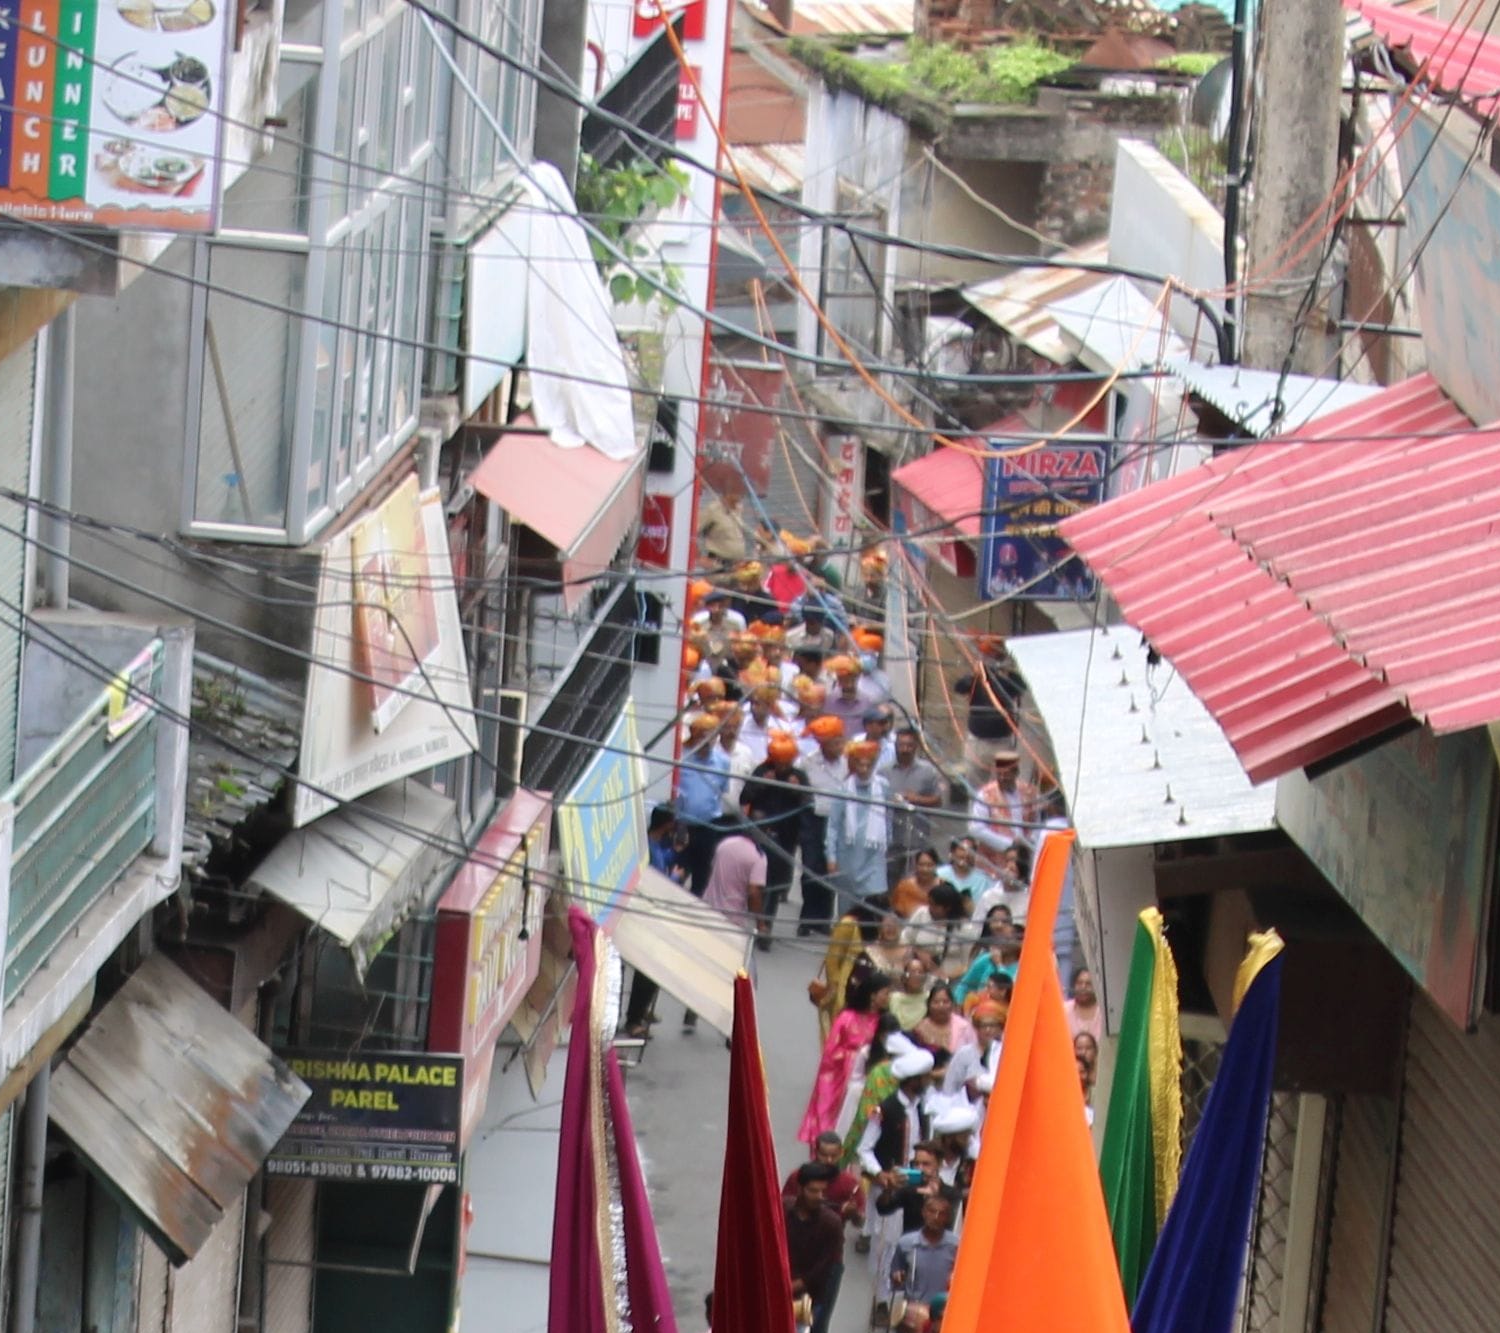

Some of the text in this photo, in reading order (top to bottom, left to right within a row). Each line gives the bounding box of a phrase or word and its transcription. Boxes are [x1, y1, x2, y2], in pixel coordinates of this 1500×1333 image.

[22, 10, 46, 174] LUNCH
[1003, 451, 1099, 478] MIRZA
[375, 1063, 457, 1087] PALACE
[331, 1088, 399, 1111] PAREL
